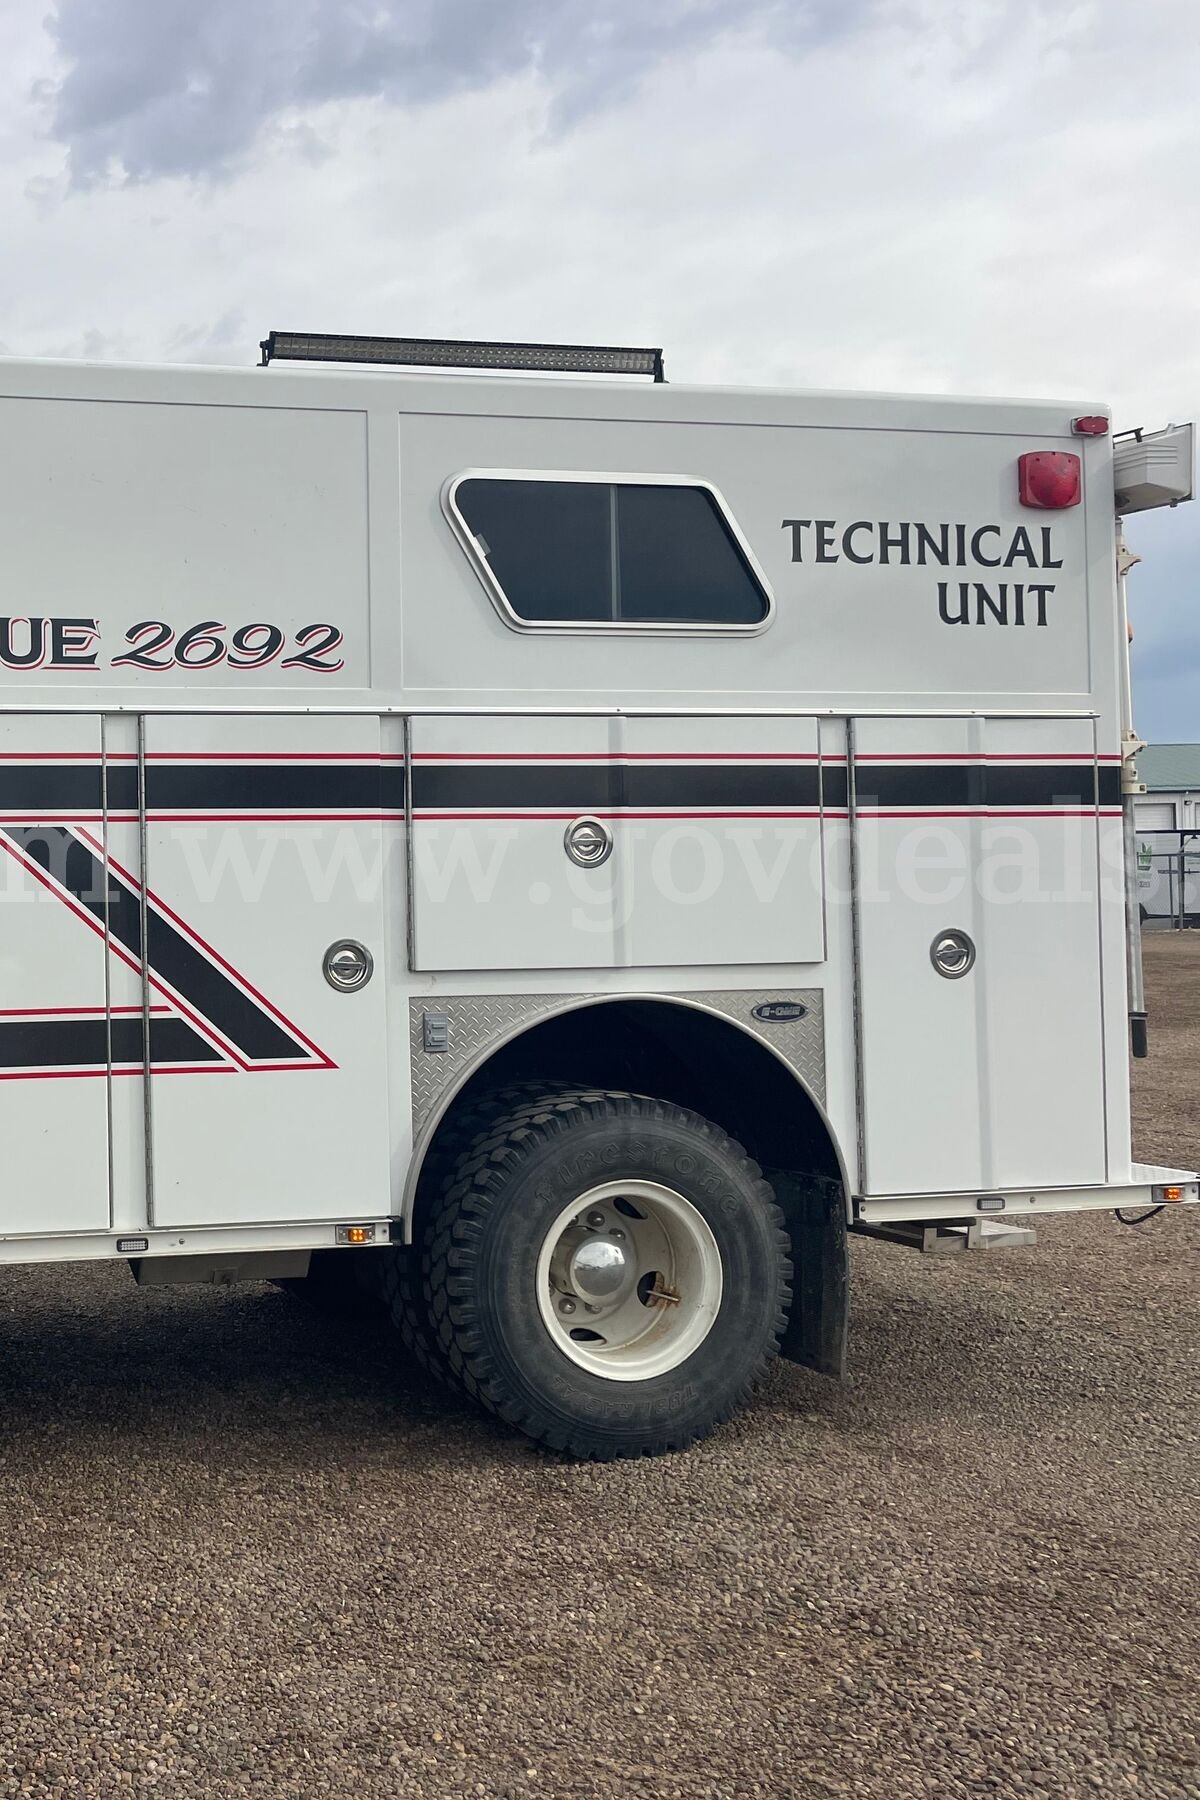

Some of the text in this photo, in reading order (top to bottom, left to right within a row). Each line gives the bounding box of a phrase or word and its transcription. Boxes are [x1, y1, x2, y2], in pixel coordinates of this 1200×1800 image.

[781, 519, 1064, 569] TECHNICAL
[937, 582, 1056, 627] UNIT
[110, 619, 346, 674] 2692
[534, 1139, 739, 1214] Firestone
